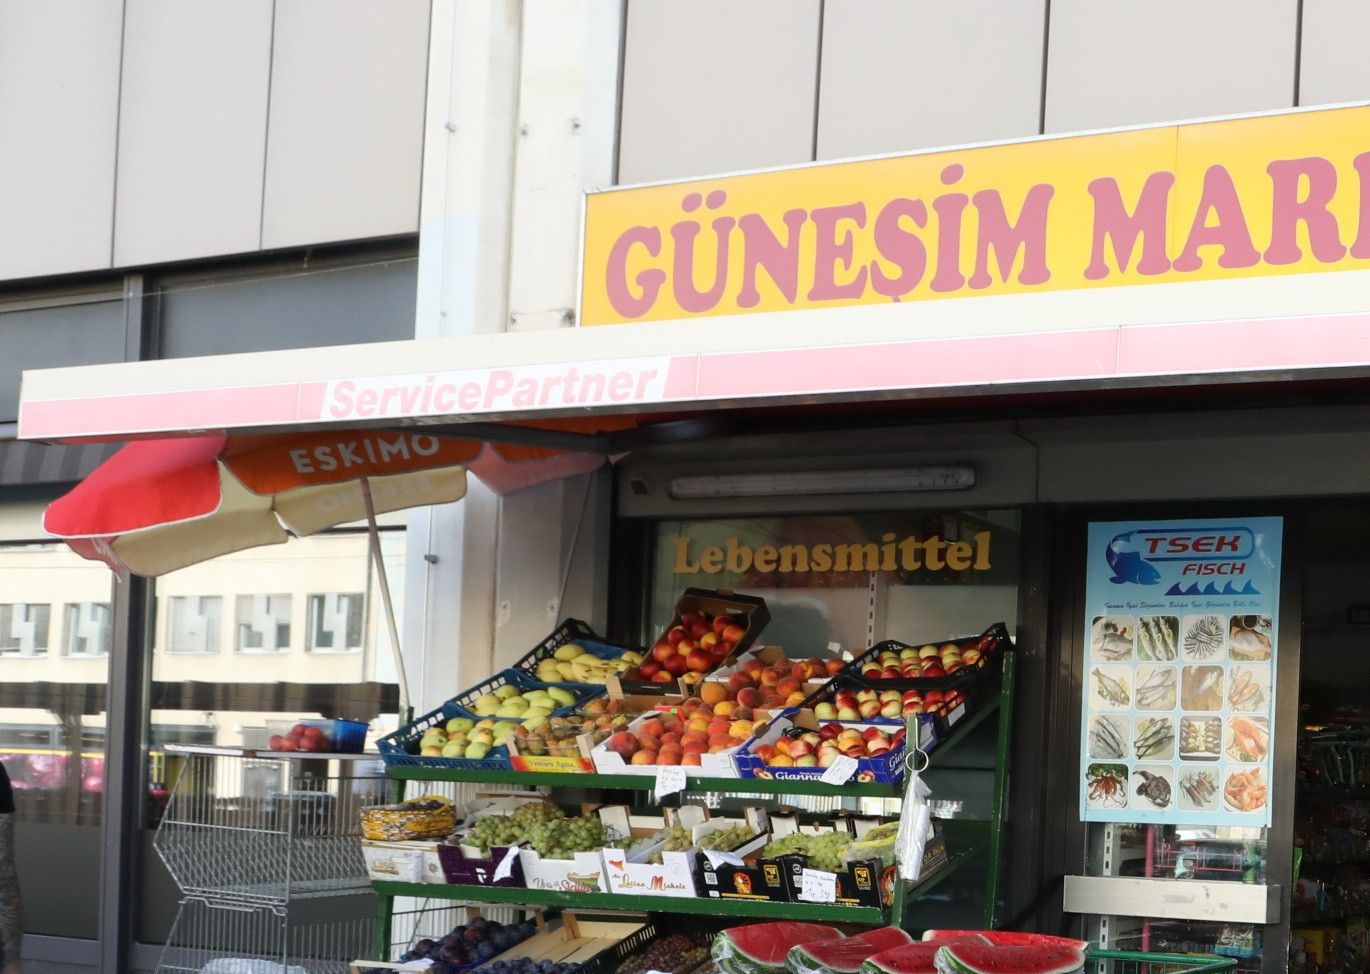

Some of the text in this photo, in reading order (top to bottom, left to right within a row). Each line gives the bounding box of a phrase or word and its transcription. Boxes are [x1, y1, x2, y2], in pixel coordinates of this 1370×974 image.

[329, 366, 659, 419] ServicePartner
[289, 434, 440, 474] ESKIMO
[672, 531, 992, 574] Lebensmittel
[1145, 535, 1241, 554] TSEK
[1182, 562, 1247, 576] FISCH
